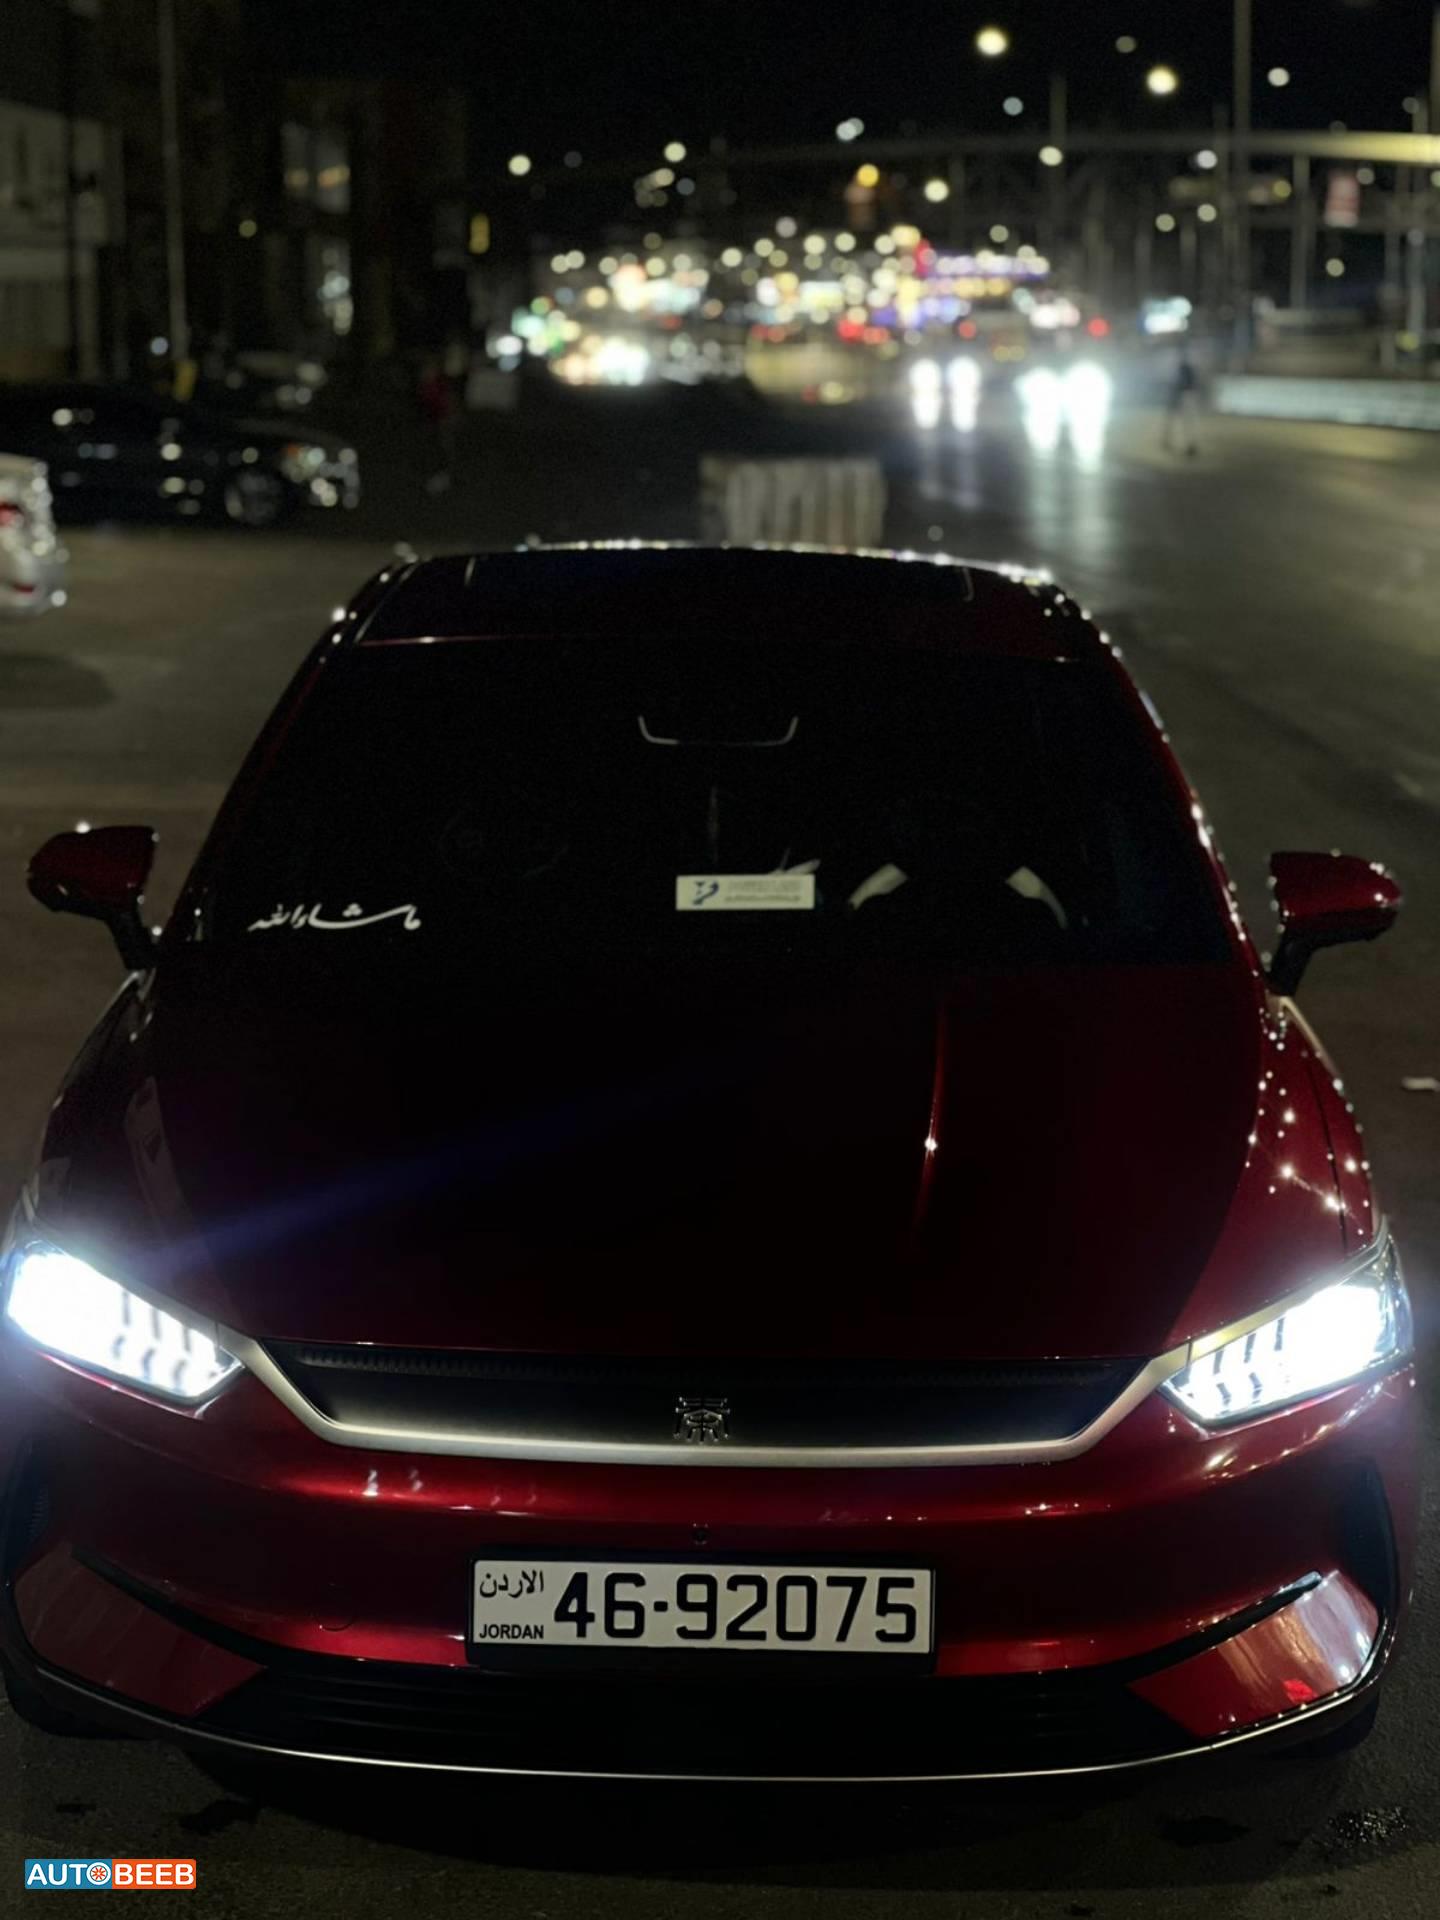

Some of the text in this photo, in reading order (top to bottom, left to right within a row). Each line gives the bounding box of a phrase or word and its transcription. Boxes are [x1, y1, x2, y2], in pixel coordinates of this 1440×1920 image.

[479, 1570, 544, 1598] الاردن
[554, 1571, 917, 1643] 46-92075
[479, 1624, 544, 1640] JORDAN
